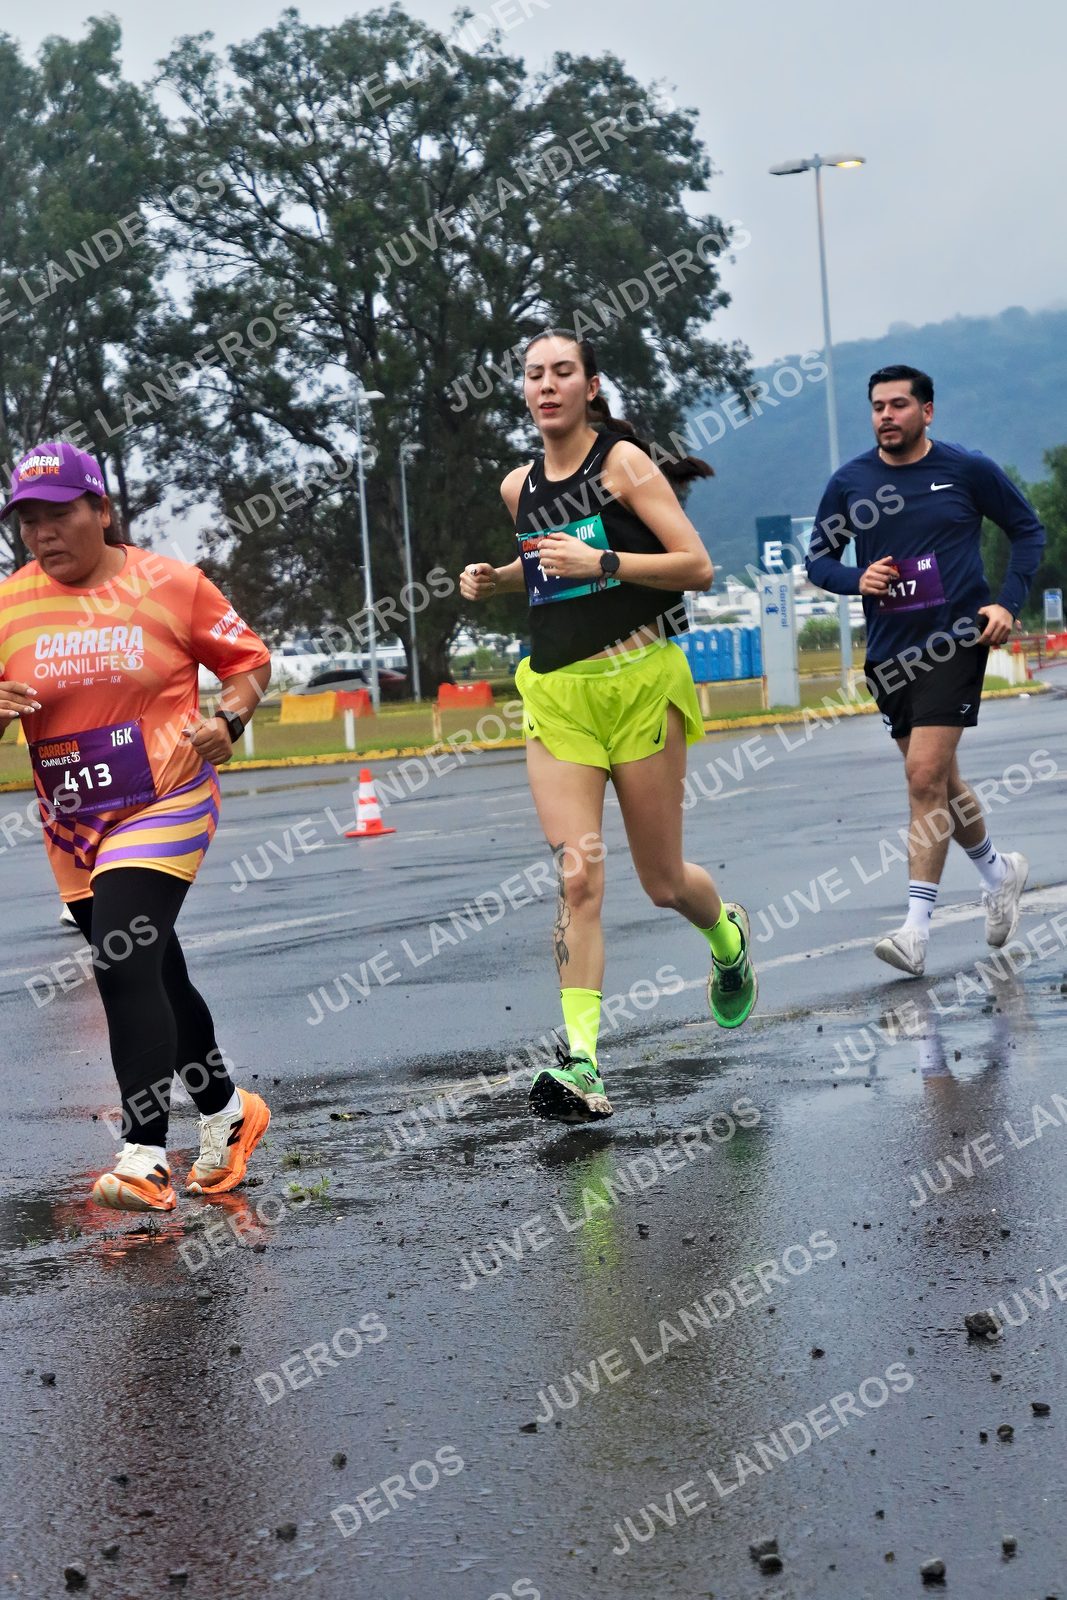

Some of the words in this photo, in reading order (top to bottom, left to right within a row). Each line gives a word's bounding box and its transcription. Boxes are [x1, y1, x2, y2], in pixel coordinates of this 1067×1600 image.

[575, 523, 596, 541] 10K
[764, 540, 783, 566] E
[887, 579, 917, 598] 417
[780, 584, 789, 627] General
[35, 625, 144, 660] CARRERA
[34, 655, 120, 679] OMNILIFE
[38, 740, 80, 758] CARRERA
[110, 727, 133, 747] 15K
[64, 763, 113, 792] 413
